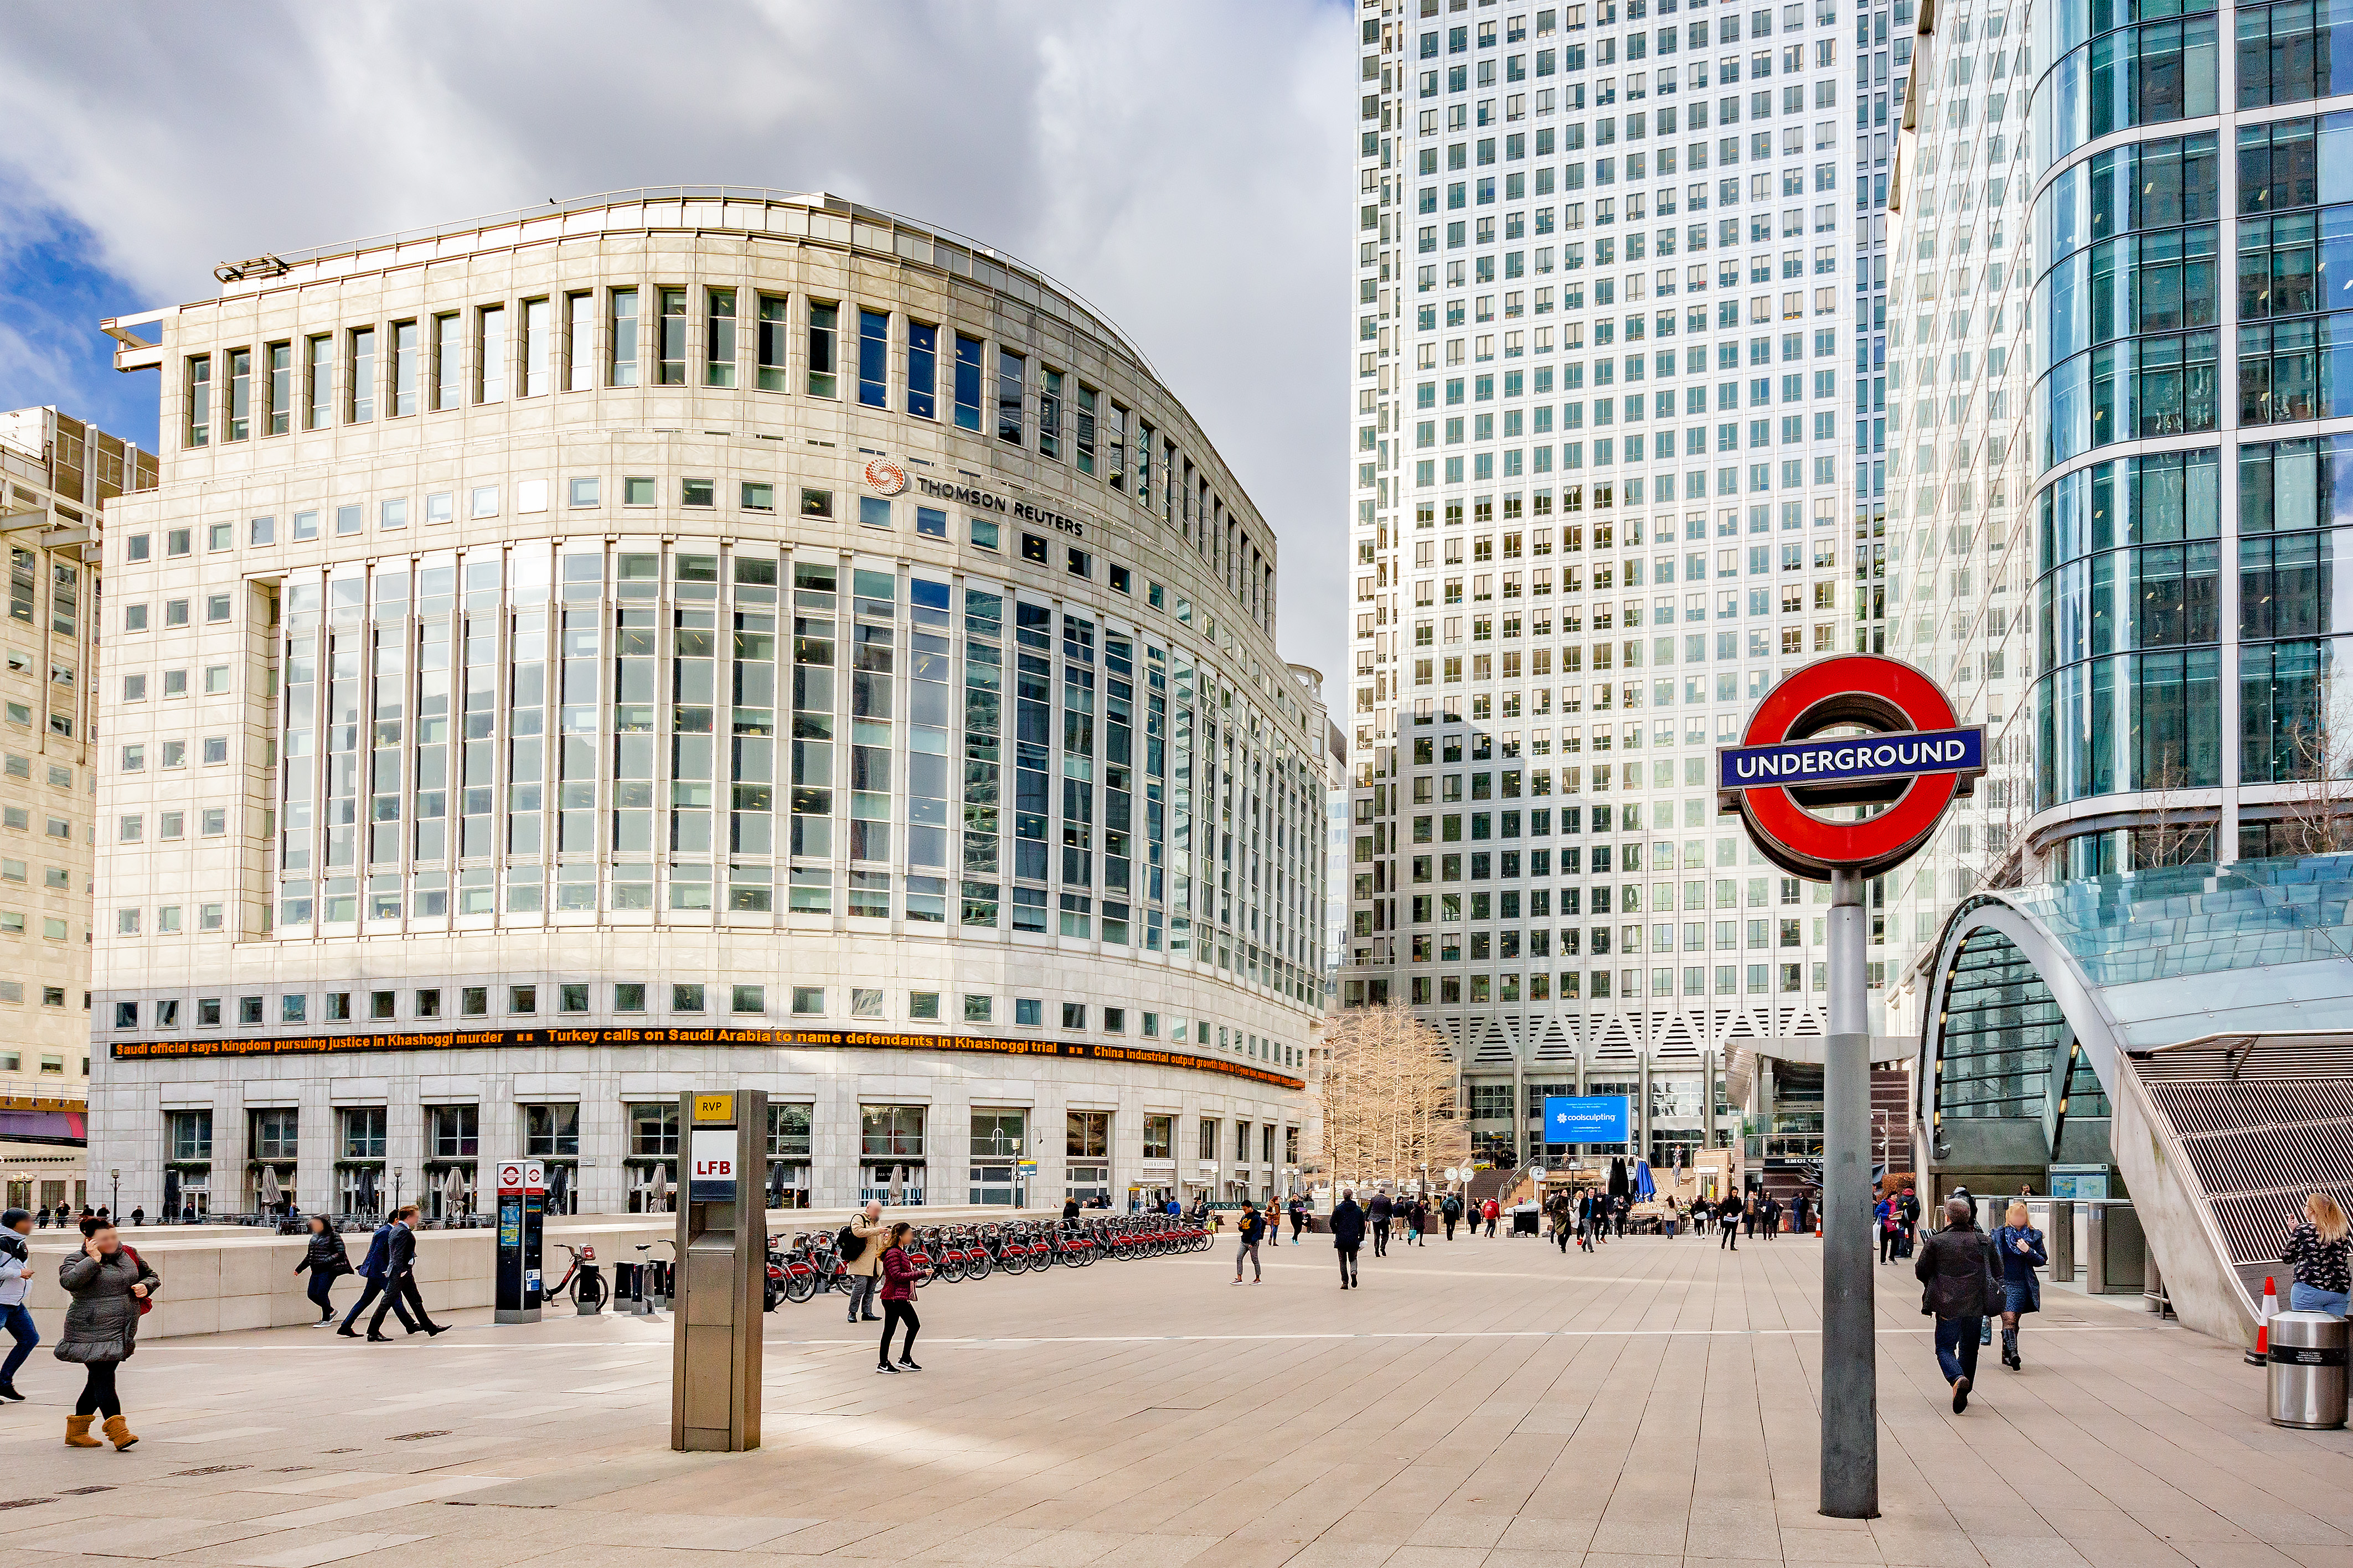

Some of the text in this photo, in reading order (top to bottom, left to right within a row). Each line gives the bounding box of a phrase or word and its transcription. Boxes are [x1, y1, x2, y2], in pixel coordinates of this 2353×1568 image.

[917, 478, 1083, 536] THOMSON REUTERS
[1736, 739, 1965, 778] UNDERGROUND
[116, 1032, 503, 1055] Saudi official says kingdom pursuing justice in Khashoggi murder
[547, 1029, 1057, 1054] Turkey calls on Saudi Arabia to name defendants in Khashoggi trial
[1094, 1046, 1123, 1058] China
[1127, 1048, 1169, 1062] industrial
[1171, 1054, 1195, 1067] output
[1196, 1058, 1217, 1069] growth
[1219, 1061, 1229, 1071] falls
[701, 1100, 722, 1112] RVP
[1567, 1114, 1616, 1122] coolsculpting
[696, 1160, 731, 1176] LFB
